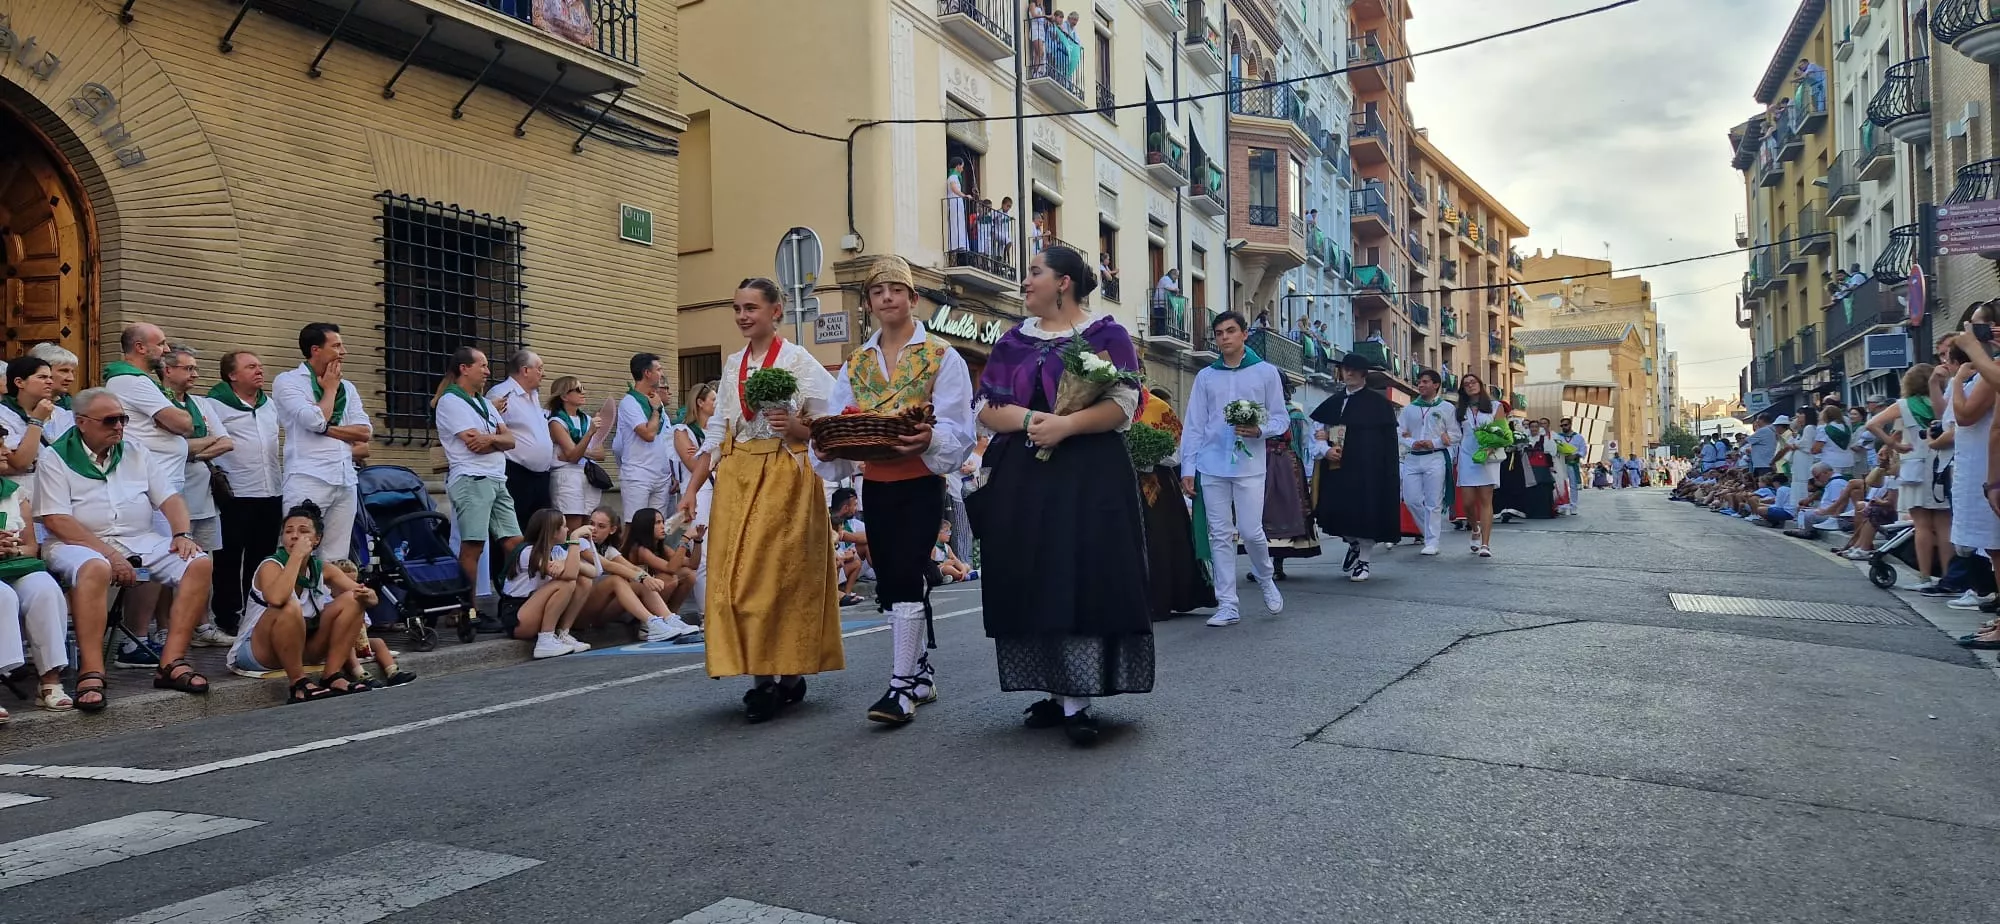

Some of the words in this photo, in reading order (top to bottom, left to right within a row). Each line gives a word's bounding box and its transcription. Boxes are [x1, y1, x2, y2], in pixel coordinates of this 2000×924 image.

[826, 323, 841, 331] SAN
[928, 304, 978, 340] Muebles
[818, 330, 845, 340] JORGE
